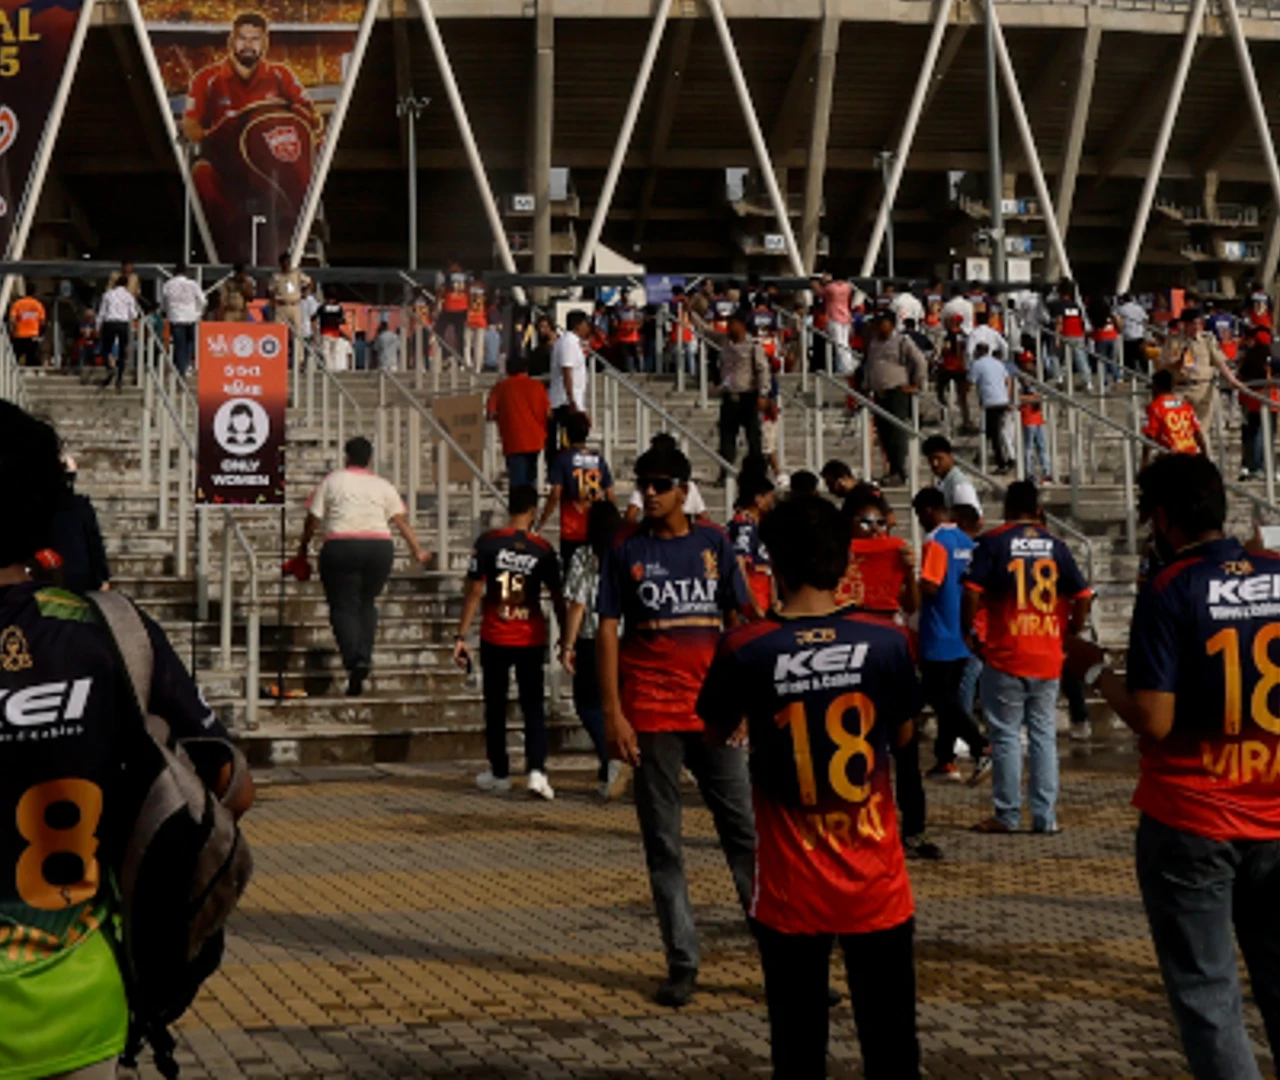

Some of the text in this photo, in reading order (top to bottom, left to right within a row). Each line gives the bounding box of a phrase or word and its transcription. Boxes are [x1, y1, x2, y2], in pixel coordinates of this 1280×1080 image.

[211, 474, 270, 487] WOMEN
[220, 458, 261, 473] ONLY
[572, 468, 601, 498] 18
[1006, 557, 1060, 614] 18
[1008, 611, 1061, 637] VIRAT
[773, 642, 870, 680] KEI
[776, 691, 877, 806] 18
